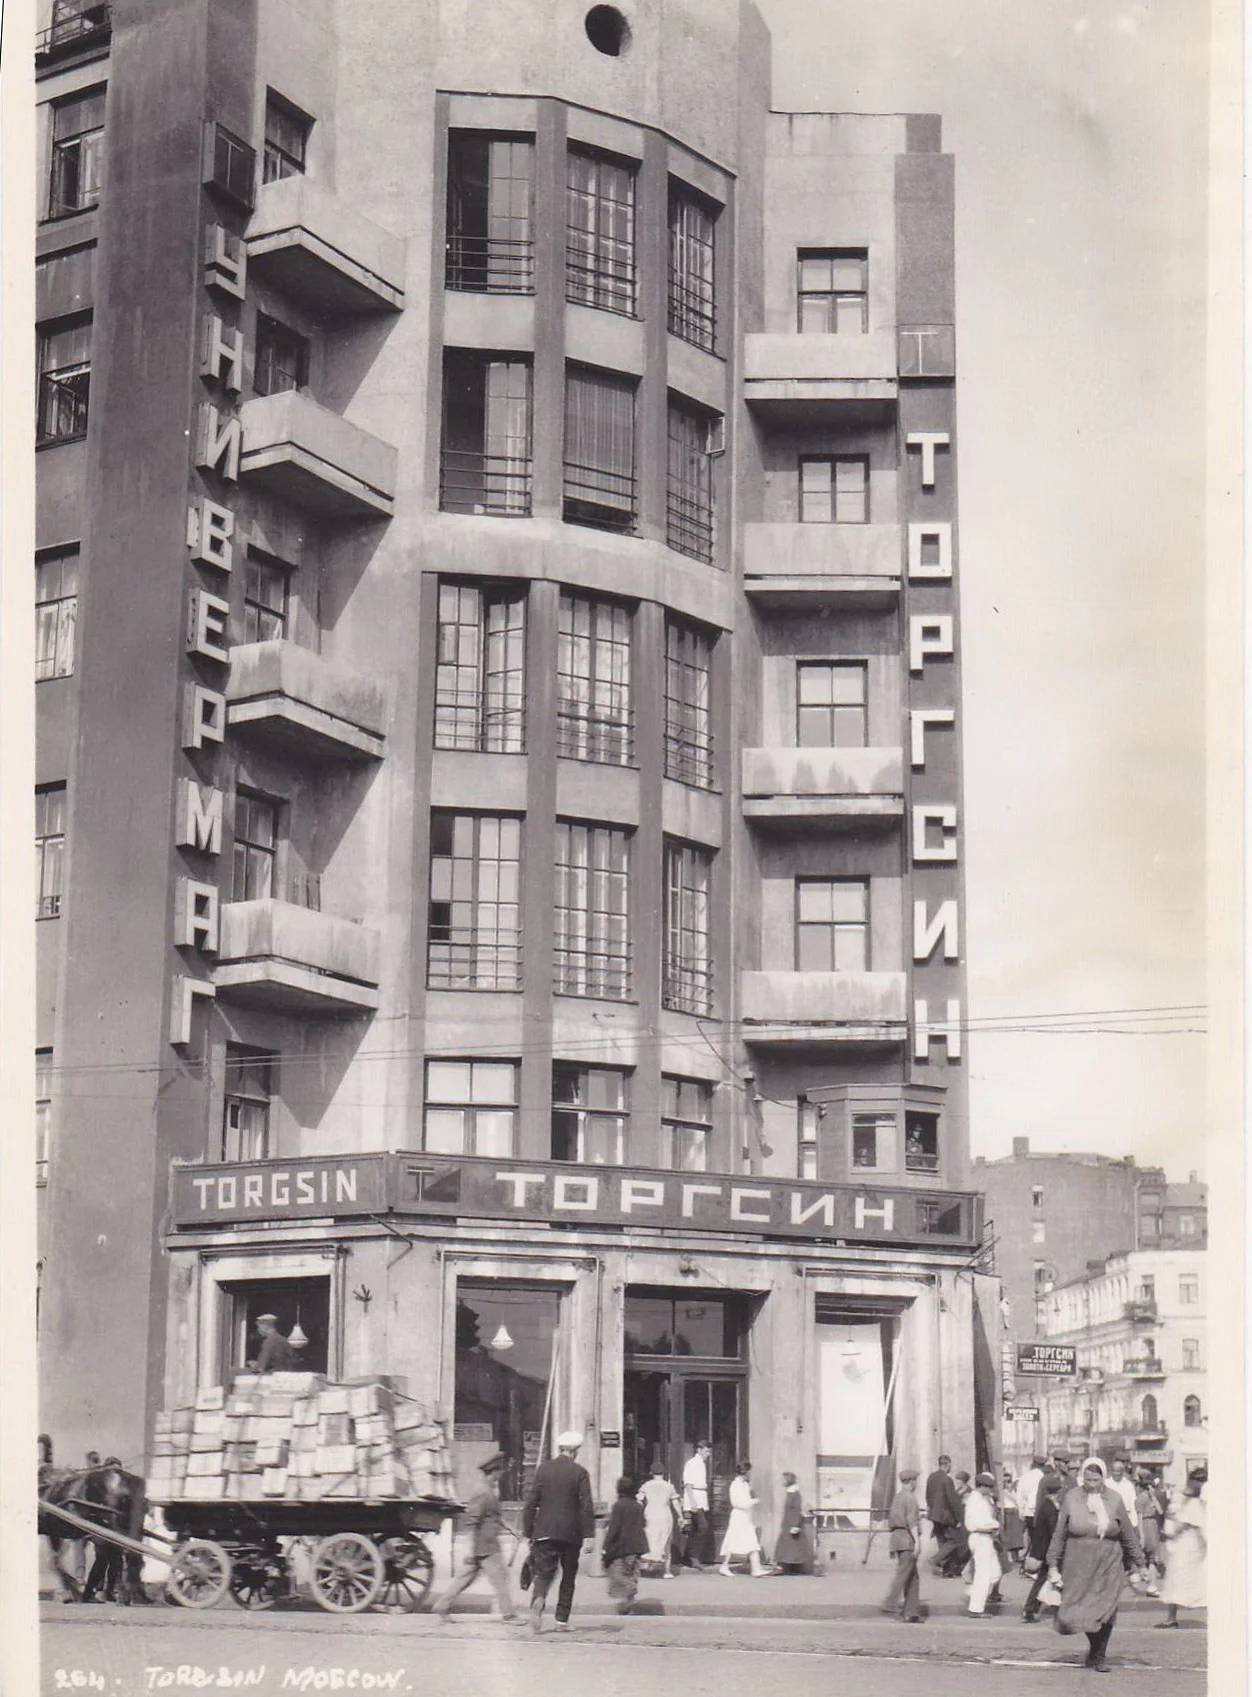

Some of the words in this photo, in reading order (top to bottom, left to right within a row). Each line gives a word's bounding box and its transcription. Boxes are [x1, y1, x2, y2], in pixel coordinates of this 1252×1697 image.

[170, 221, 247, 1045] УНИВЕРМАГ
[906, 432, 961, 1060] ТОРГСИН
[192, 1168, 358, 1211] TORGSIN
[495, 1171, 895, 1231] ТОРГСИН
